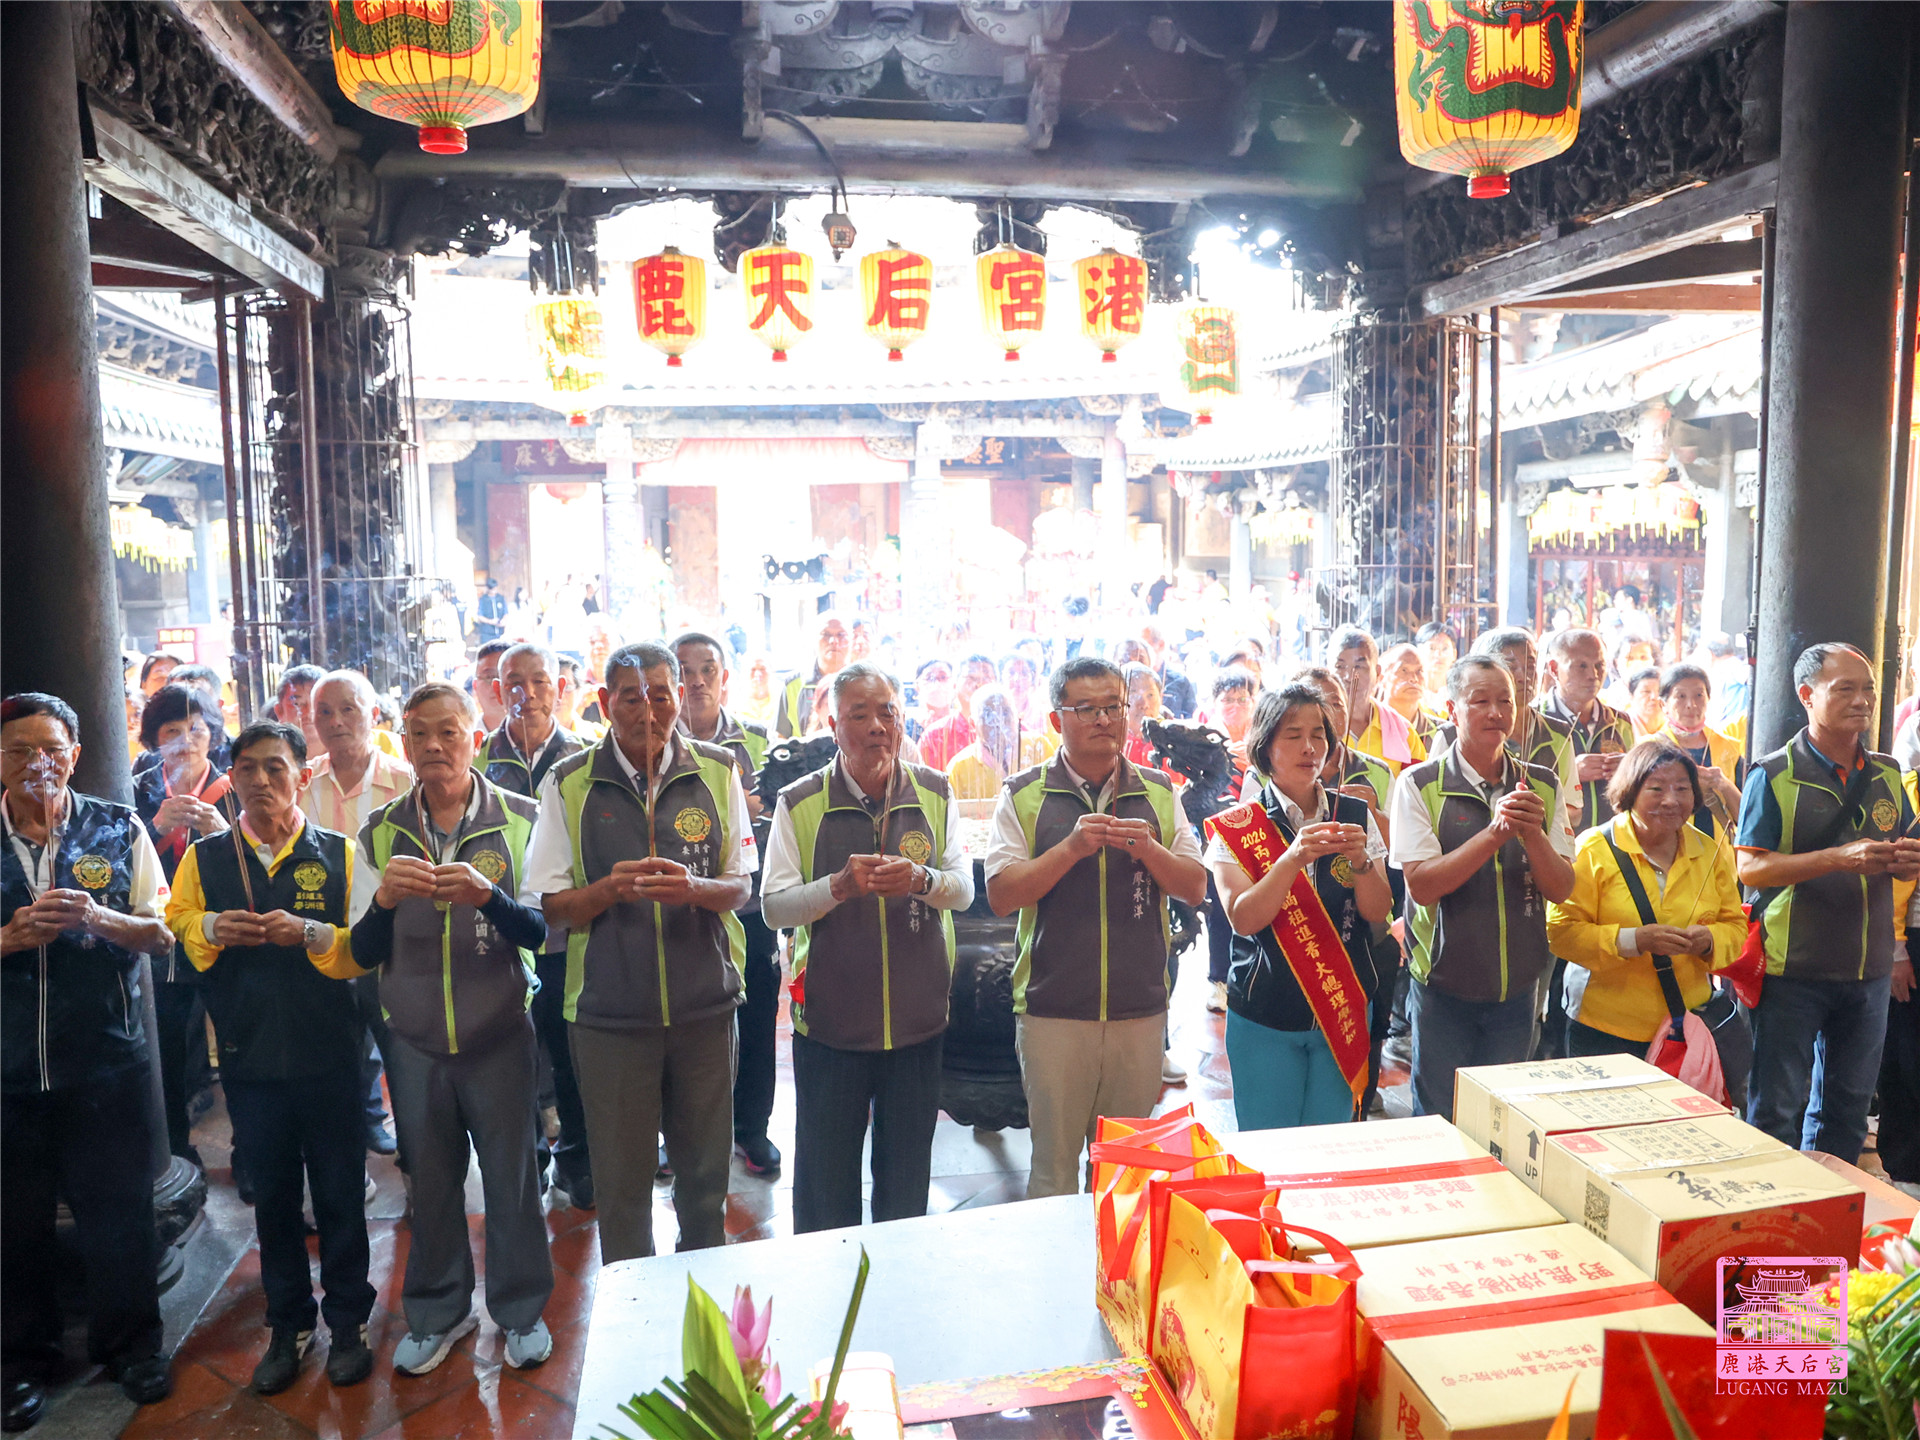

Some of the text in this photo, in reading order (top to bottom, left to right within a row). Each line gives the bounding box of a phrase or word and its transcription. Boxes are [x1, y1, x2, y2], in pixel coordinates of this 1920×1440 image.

[639, 253, 1143, 337] 鹿 天 后 宮 港
[1241, 827, 1267, 849] 2026
[1525, 1162, 1538, 1180] UP
[1285, 1179, 1476, 1208] 野鹿牌陽春麵
[1325, 1199, 1465, 1222] 避免陽光直射
[1415, 1249, 1564, 1278] 避免陽光直射
[1404, 1261, 1614, 1302] 野鹿牌陽春麵
